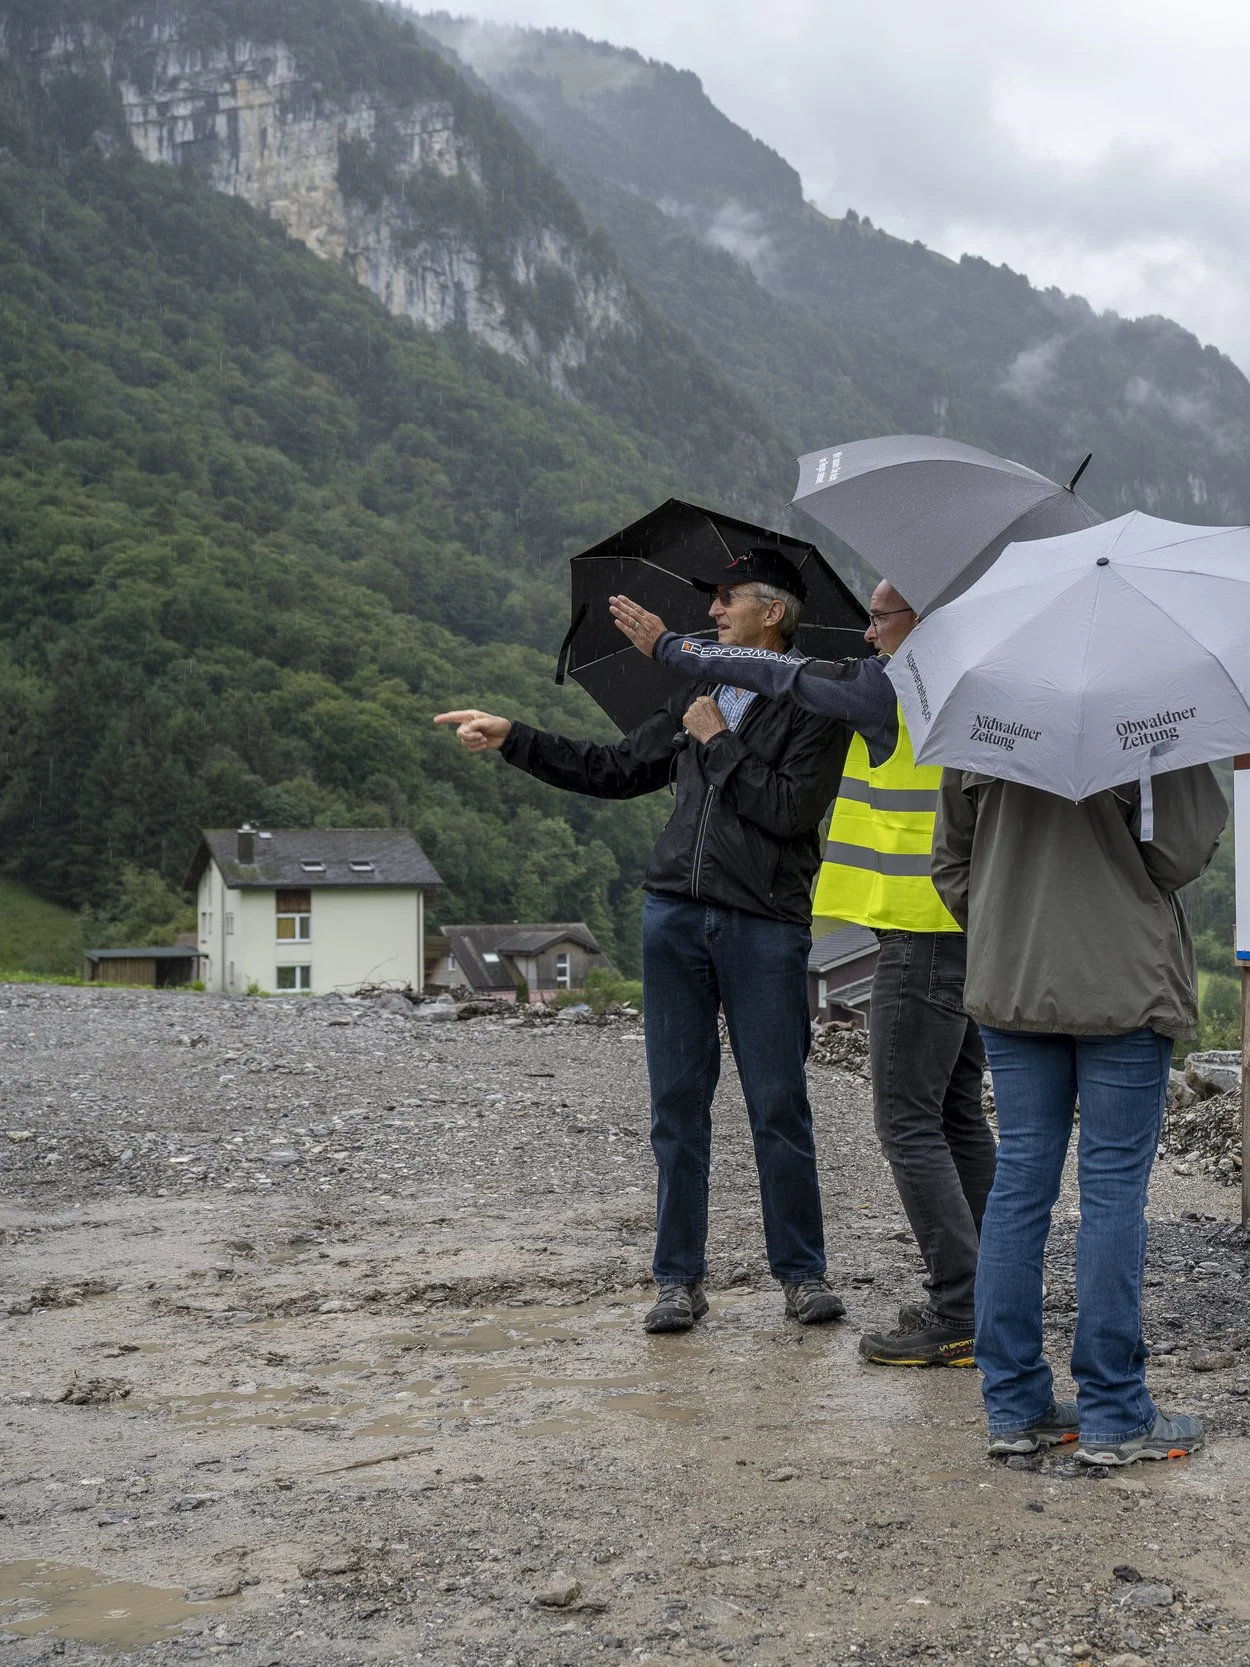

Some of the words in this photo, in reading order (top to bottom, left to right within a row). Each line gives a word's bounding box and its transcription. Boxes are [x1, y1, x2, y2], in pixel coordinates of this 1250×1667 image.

[906, 650, 932, 725] luzernerzeitung.ch
[973, 715, 1042, 741] Nidwaldner
[1116, 706, 1196, 736] Obwaldner
[970, 727, 1016, 751] Zeitung
[1119, 726, 1180, 750] Zeitung
